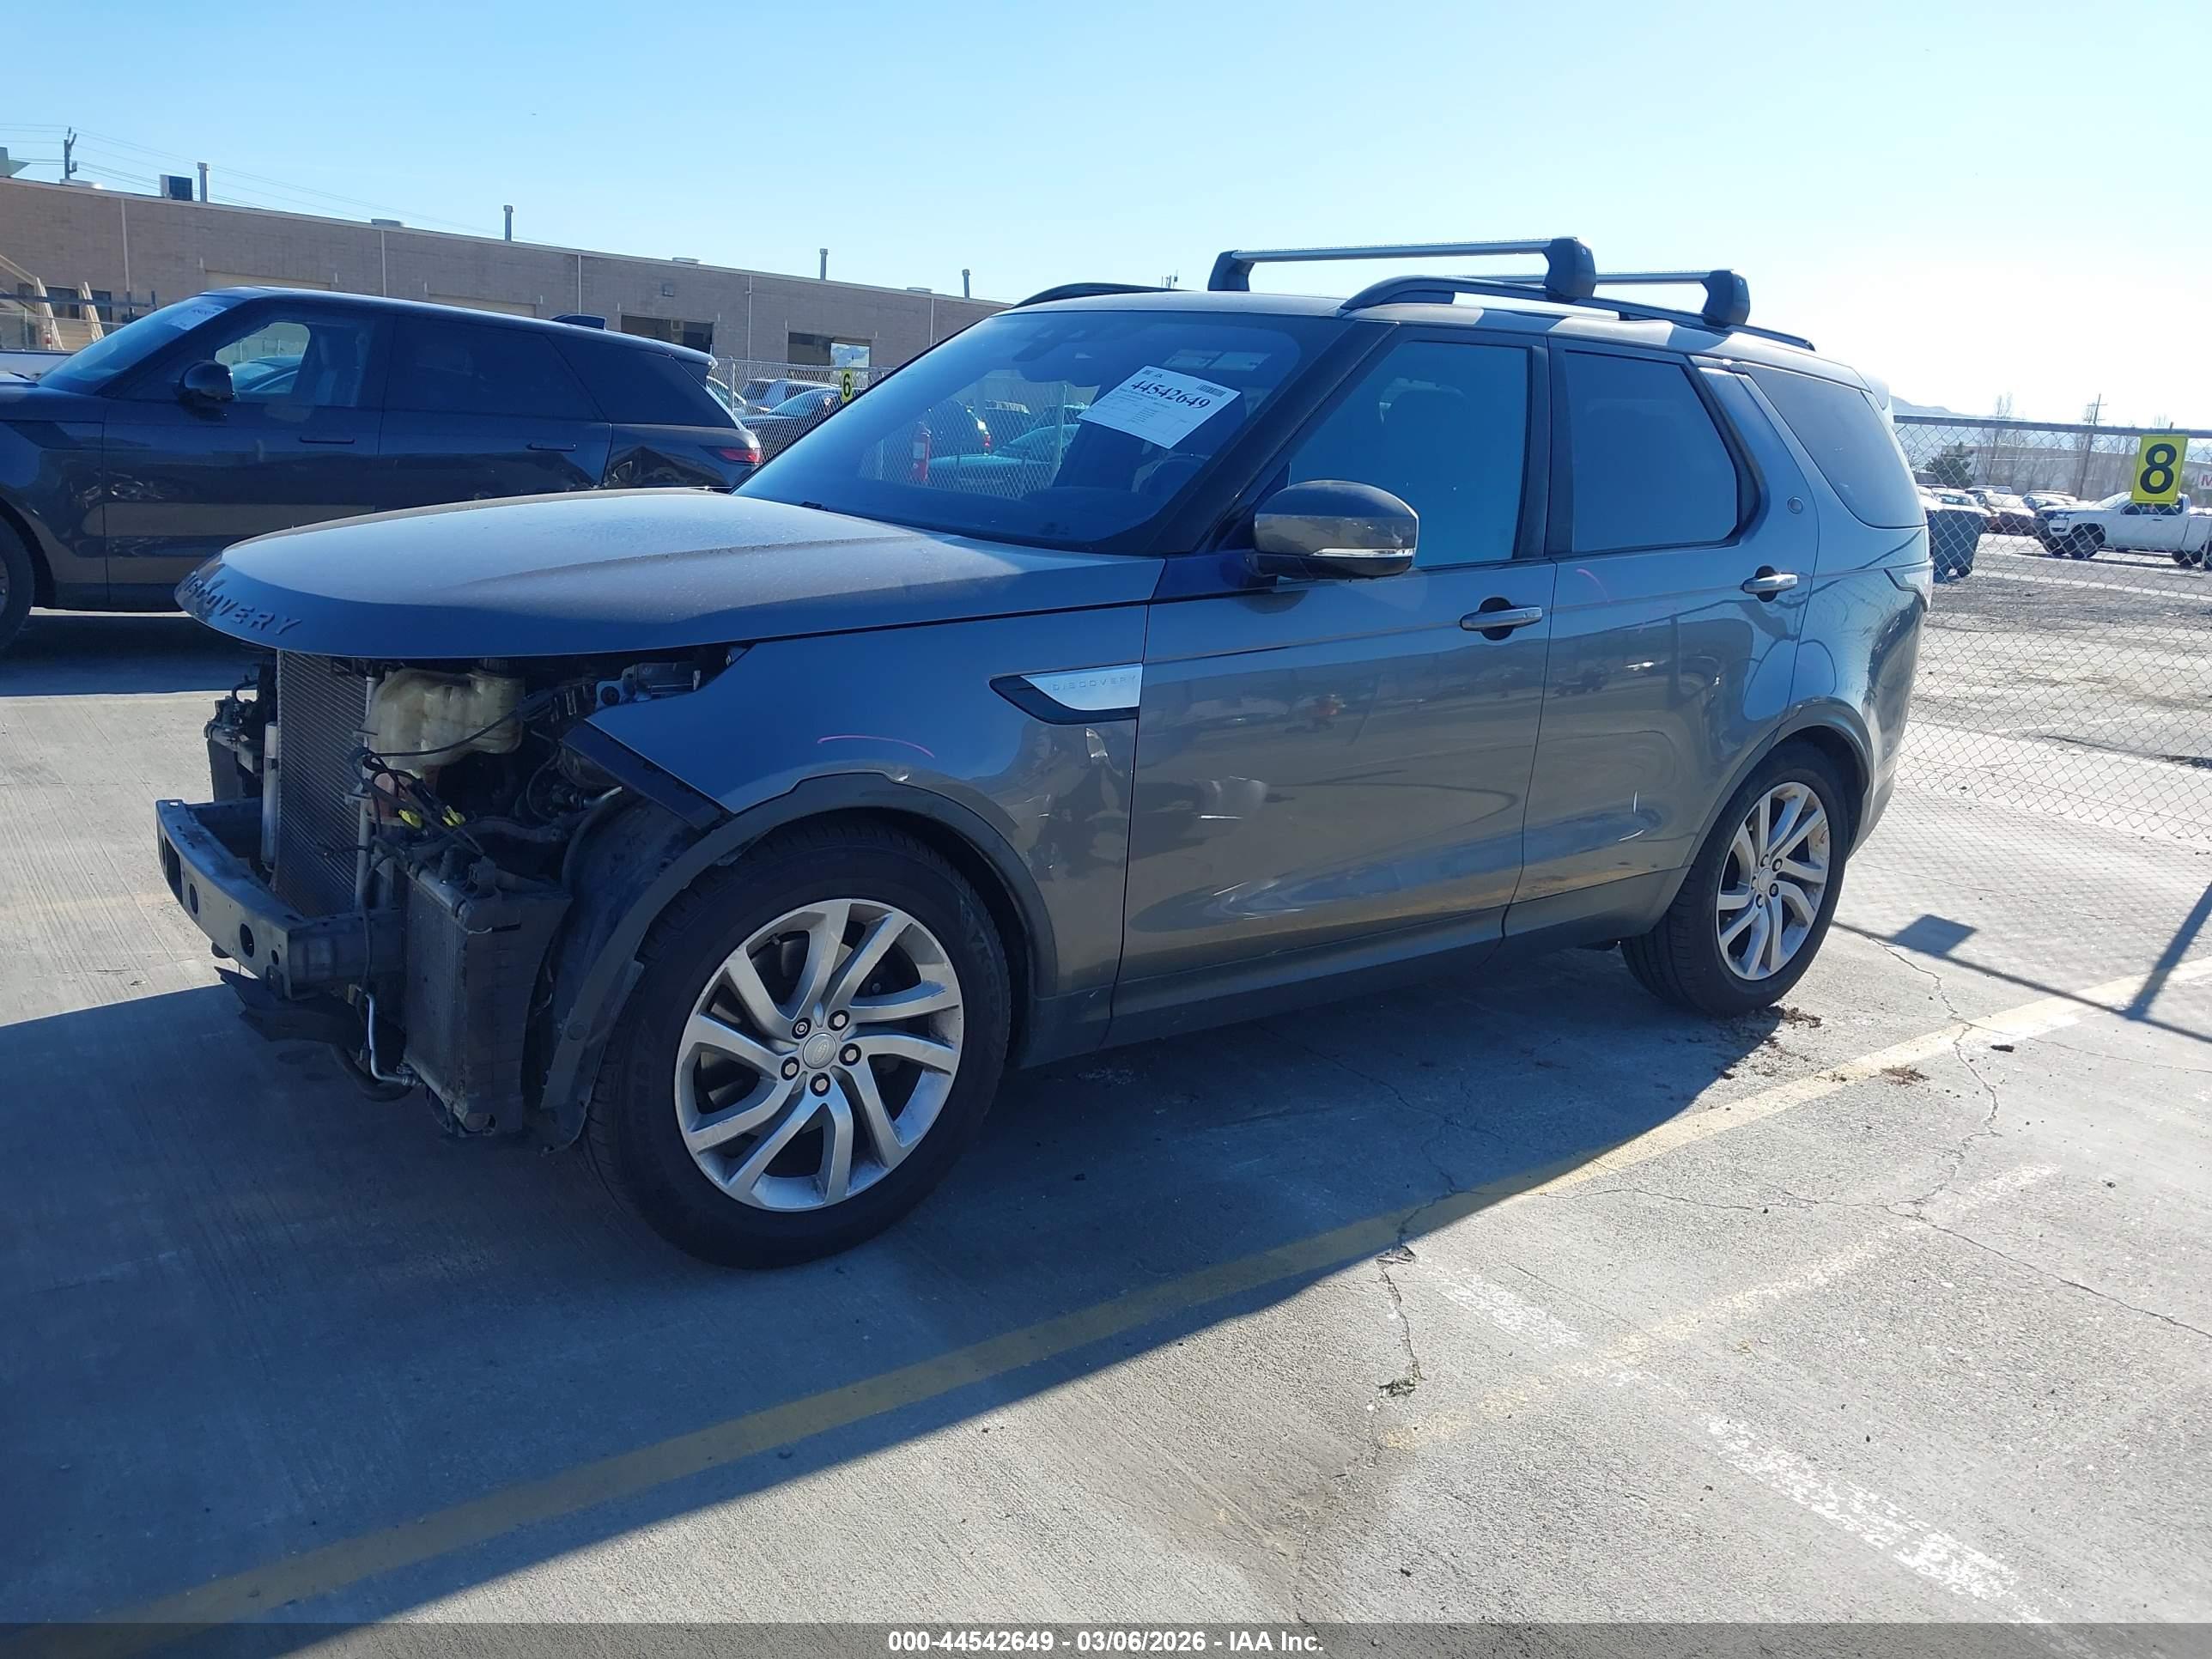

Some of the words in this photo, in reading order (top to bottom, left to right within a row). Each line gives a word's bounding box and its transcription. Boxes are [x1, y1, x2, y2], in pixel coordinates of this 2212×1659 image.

[842, 373, 852, 398] 6
[1131, 380, 1212, 410] 44542649
[2139, 443, 2178, 495] 8
[1052, 675, 1137, 691] DISCOVERY
